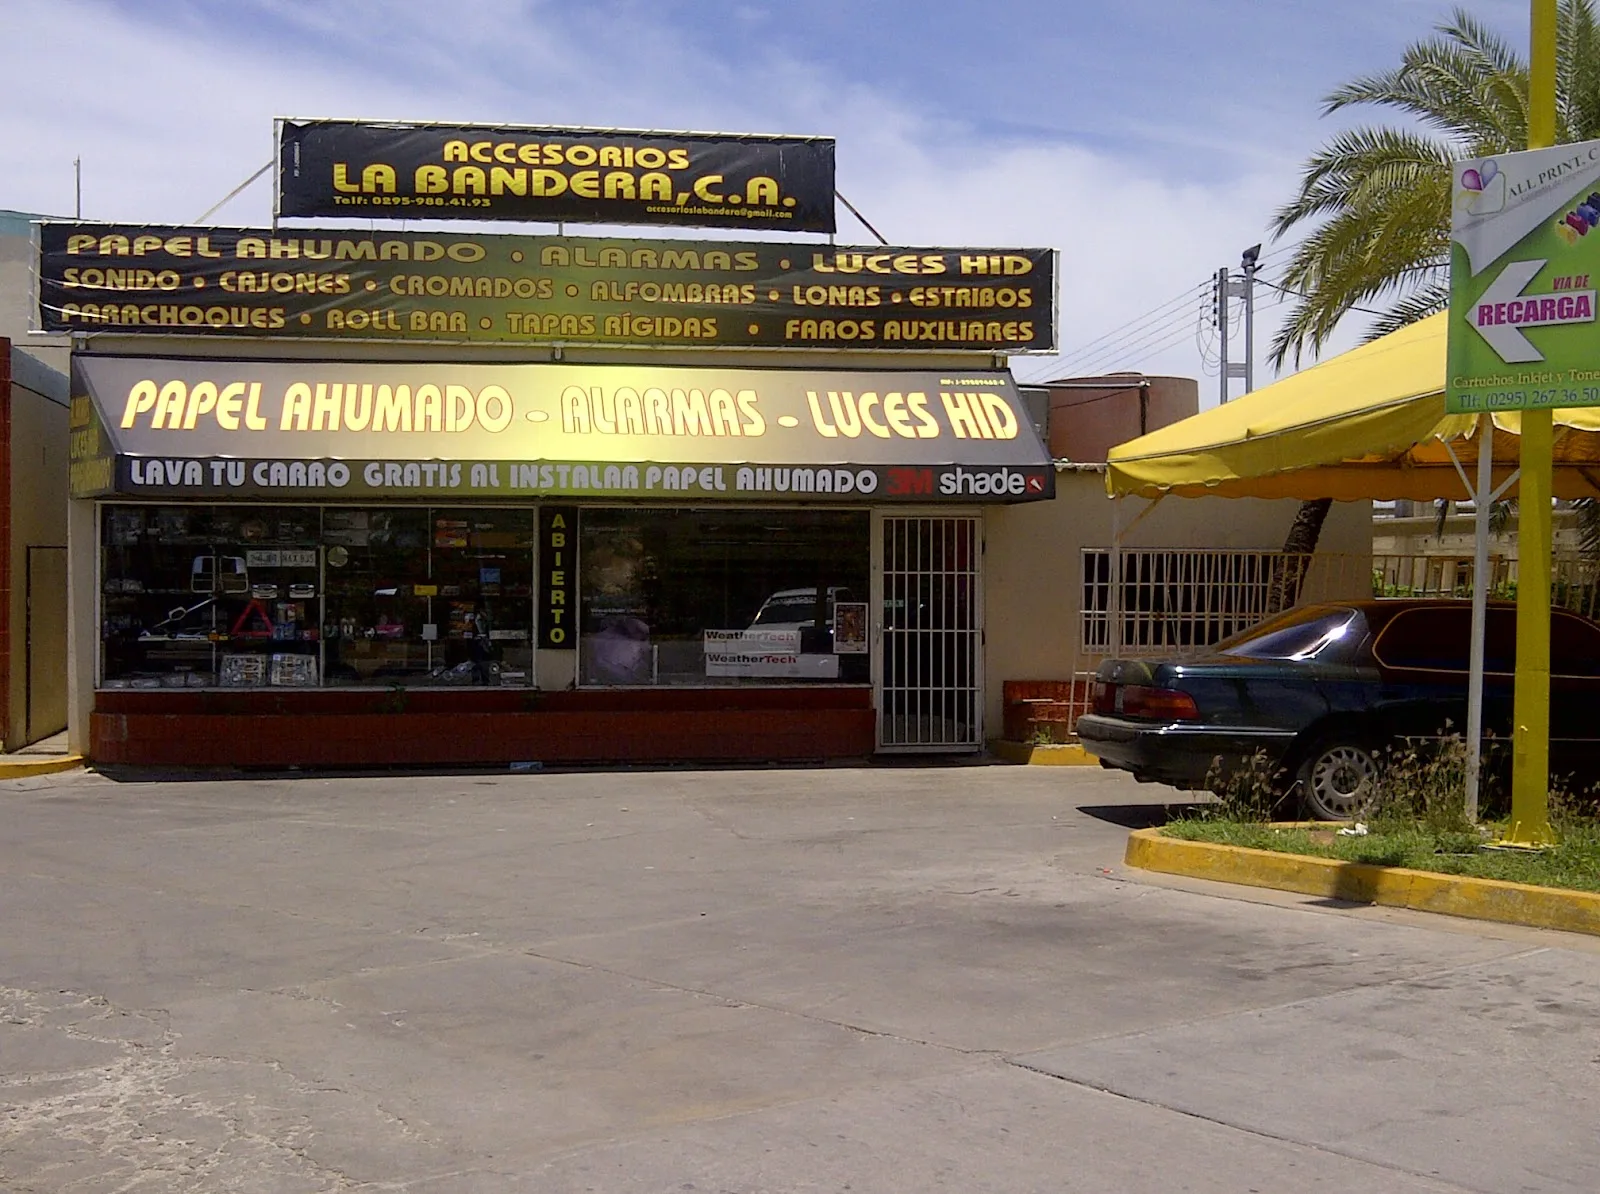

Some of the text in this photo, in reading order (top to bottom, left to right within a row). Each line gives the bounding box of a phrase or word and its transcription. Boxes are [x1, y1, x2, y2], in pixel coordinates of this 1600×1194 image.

[443, 141, 690, 170] ACCESORIOS
[332, 163, 396, 193] LA
[1508, 178, 1537, 199] ALL
[333, 196, 492, 207] Telf: 0295-988.41.93
[66, 234, 1034, 276] PAPEL AHUMADO ALARMAS LUCES HID
[62, 267, 1033, 309] SONIDO CAJONES CROMADOS ALFOMBRAS LONAS ESTRIBOS
[1553, 274, 1591, 290] VIA DE
[61, 303, 1034, 342] PARACHOQUES ROLL BAR TAPAS RÍGIDAS FAROS AUXILIARES
[1477, 295, 1592, 327] RECARGA
[1453, 374, 1514, 389] Cartuchos
[1518, 372, 1553, 386] Inkjet
[1556, 373, 1565, 383] y
[120, 379, 268, 431] PAPEL
[279, 382, 515, 433] AHUMADO
[560, 384, 767, 437] ALARMAS
[806, 390, 941, 440] LUCES
[940, 391, 1019, 441] HID
[1458, 394, 1480, 408] Tlf:
[1486, 391, 1527, 409] (0295)
[131, 459, 203, 487] LAVA
[210, 461, 246, 487] TU
[252, 461, 351, 488] CARRO
[364, 462, 463, 488] GRATIS
[470, 462, 501, 488] AL
[509, 463, 640, 491] INSTALAR
[645, 466, 726, 492] PAPEL
[736, 467, 878, 494] AHUMADO
[886, 467, 933, 494] 3M
[939, 465, 1026, 496] shade
[549, 513, 567, 644] ABIERTO
[706, 630, 796, 642] WeatherTech
[708, 654, 798, 665] WeatherTech
